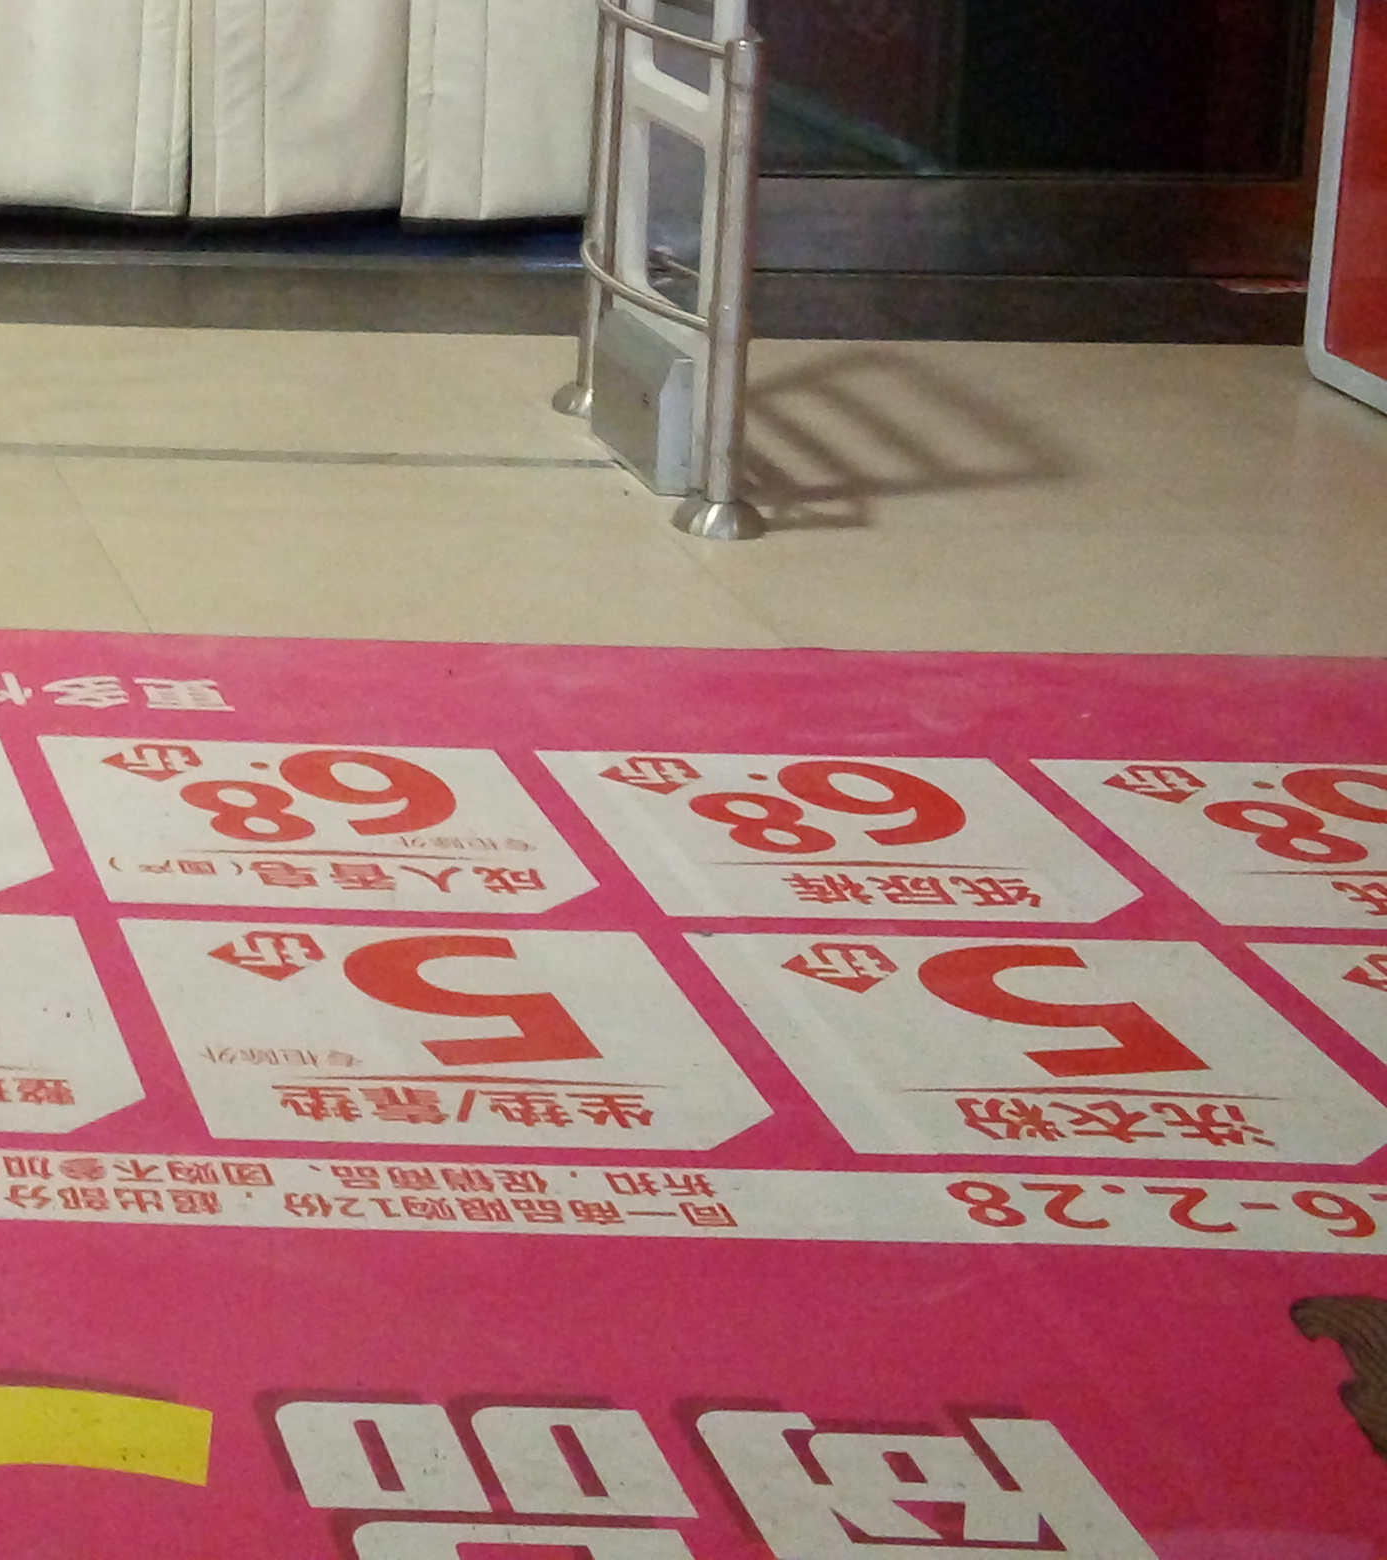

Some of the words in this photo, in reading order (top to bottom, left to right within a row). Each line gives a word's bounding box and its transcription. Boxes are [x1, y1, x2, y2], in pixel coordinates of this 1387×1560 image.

[781, 873, 1042, 908] 纸尿裤
[272, 1085, 654, 1128] 坐垫/靠垫
[955, 1098, 1275, 1147] 洗衣粉
[946, 1180, 1387, 1239] 6-2.28
